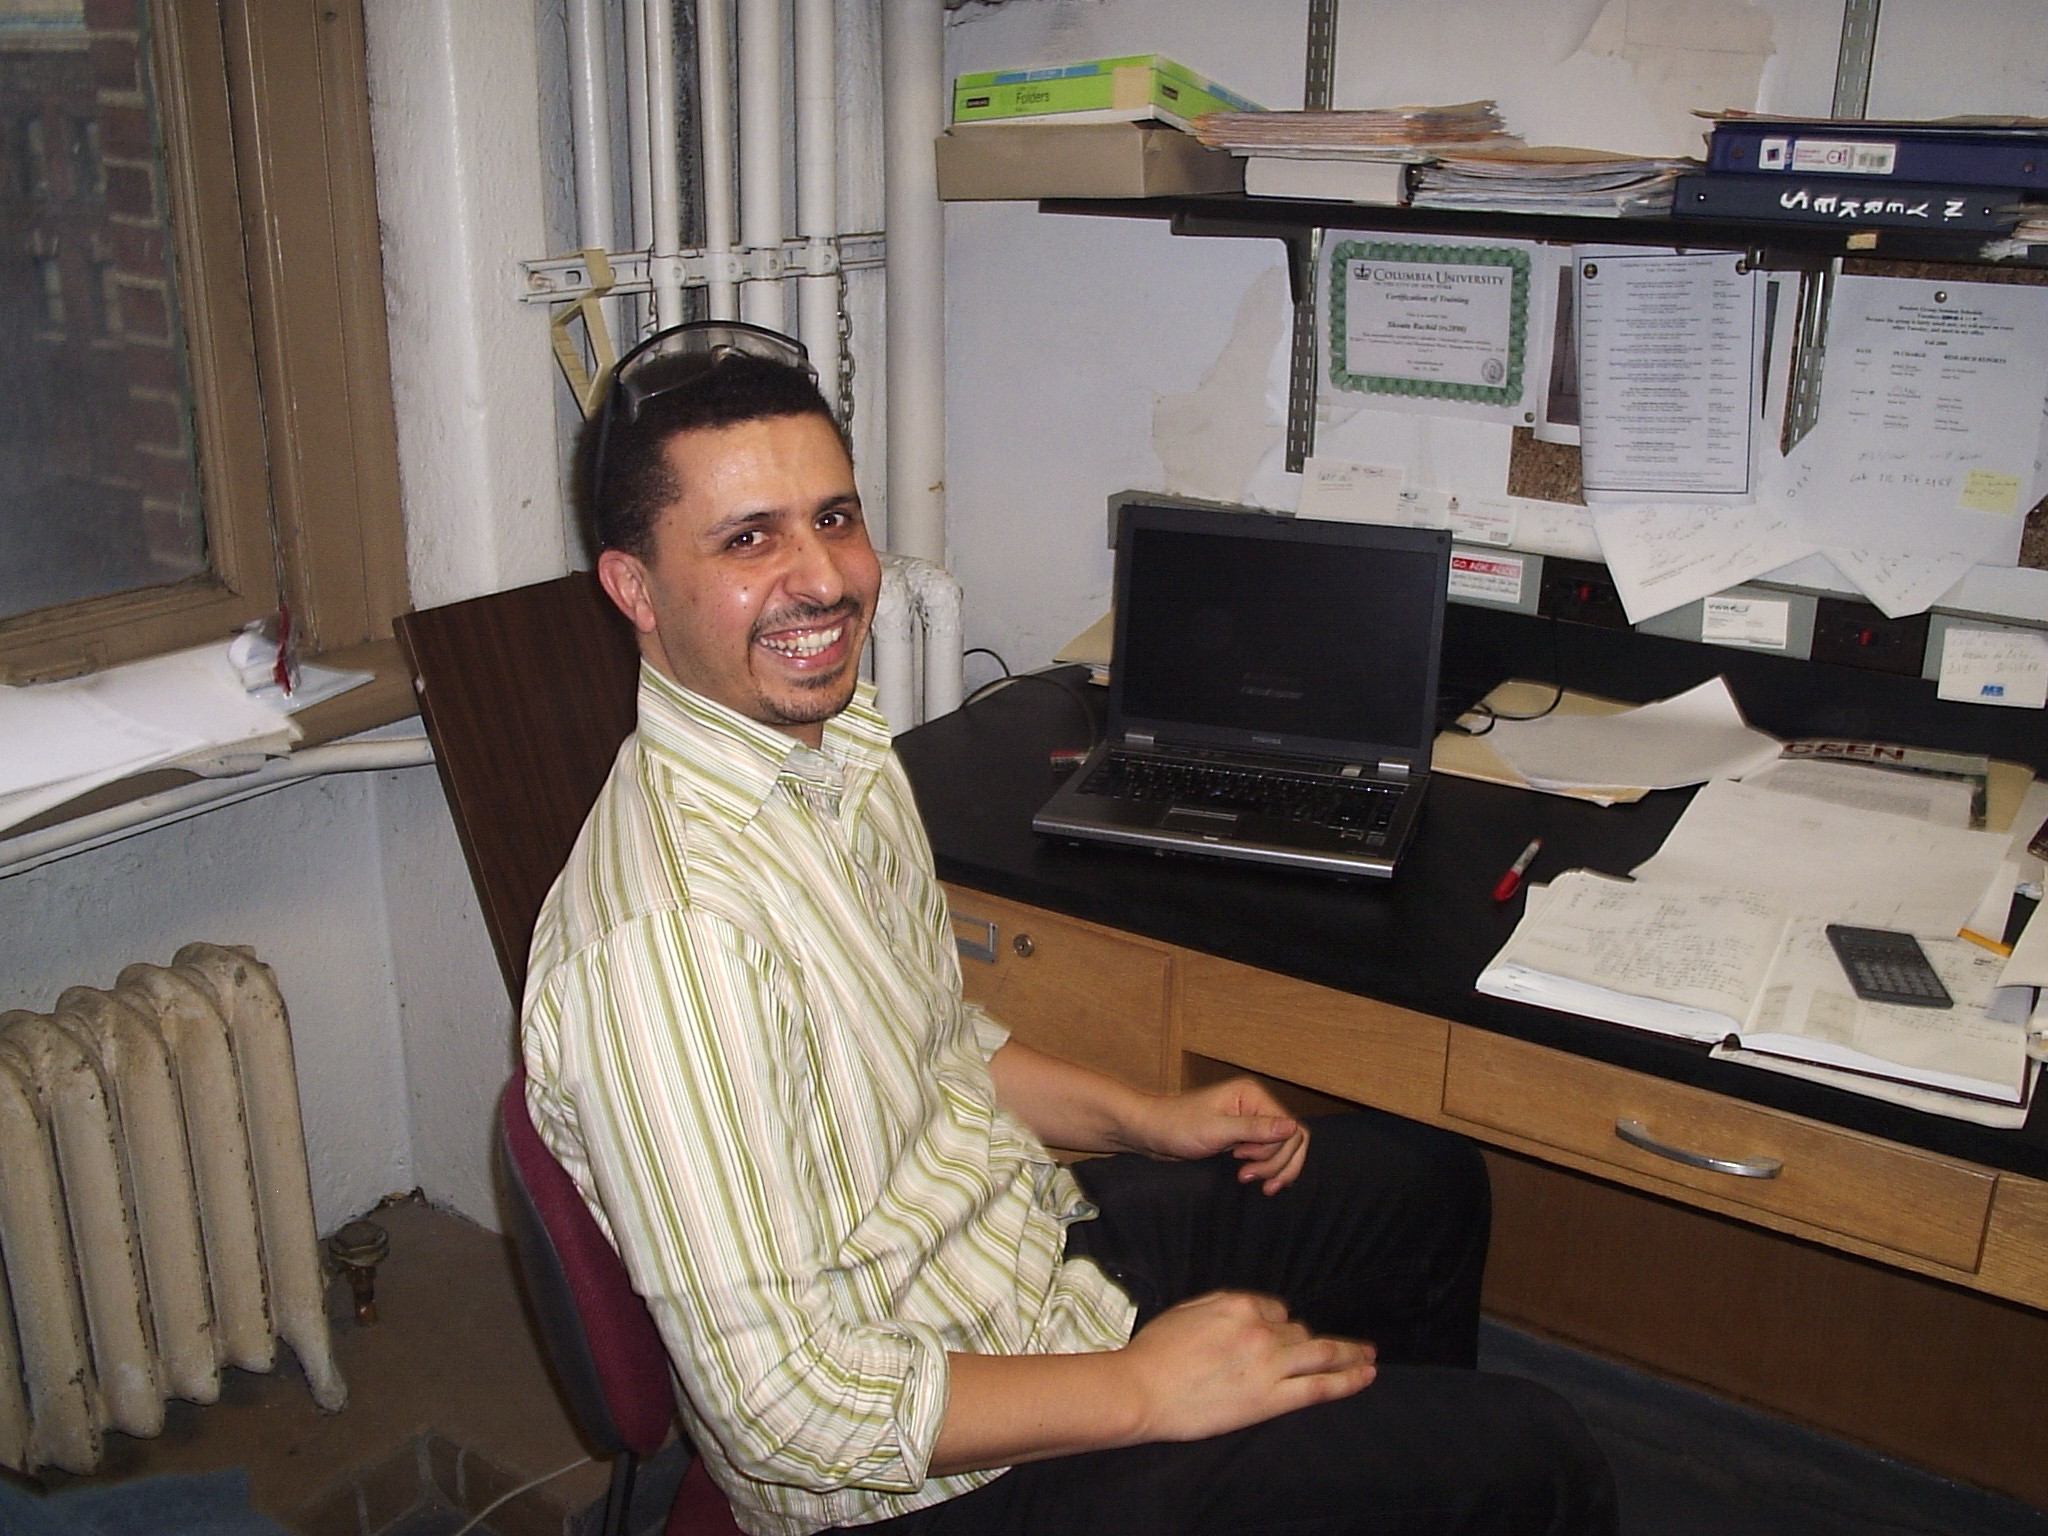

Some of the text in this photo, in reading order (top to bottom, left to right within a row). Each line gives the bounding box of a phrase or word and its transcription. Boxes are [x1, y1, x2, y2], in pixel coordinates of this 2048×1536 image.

[1016, 92, 1050, 104] Folders
[1780, 191, 1930, 219] YERKES
[1373, 268, 1505, 286] COLUMBIA UNIVERSITY
